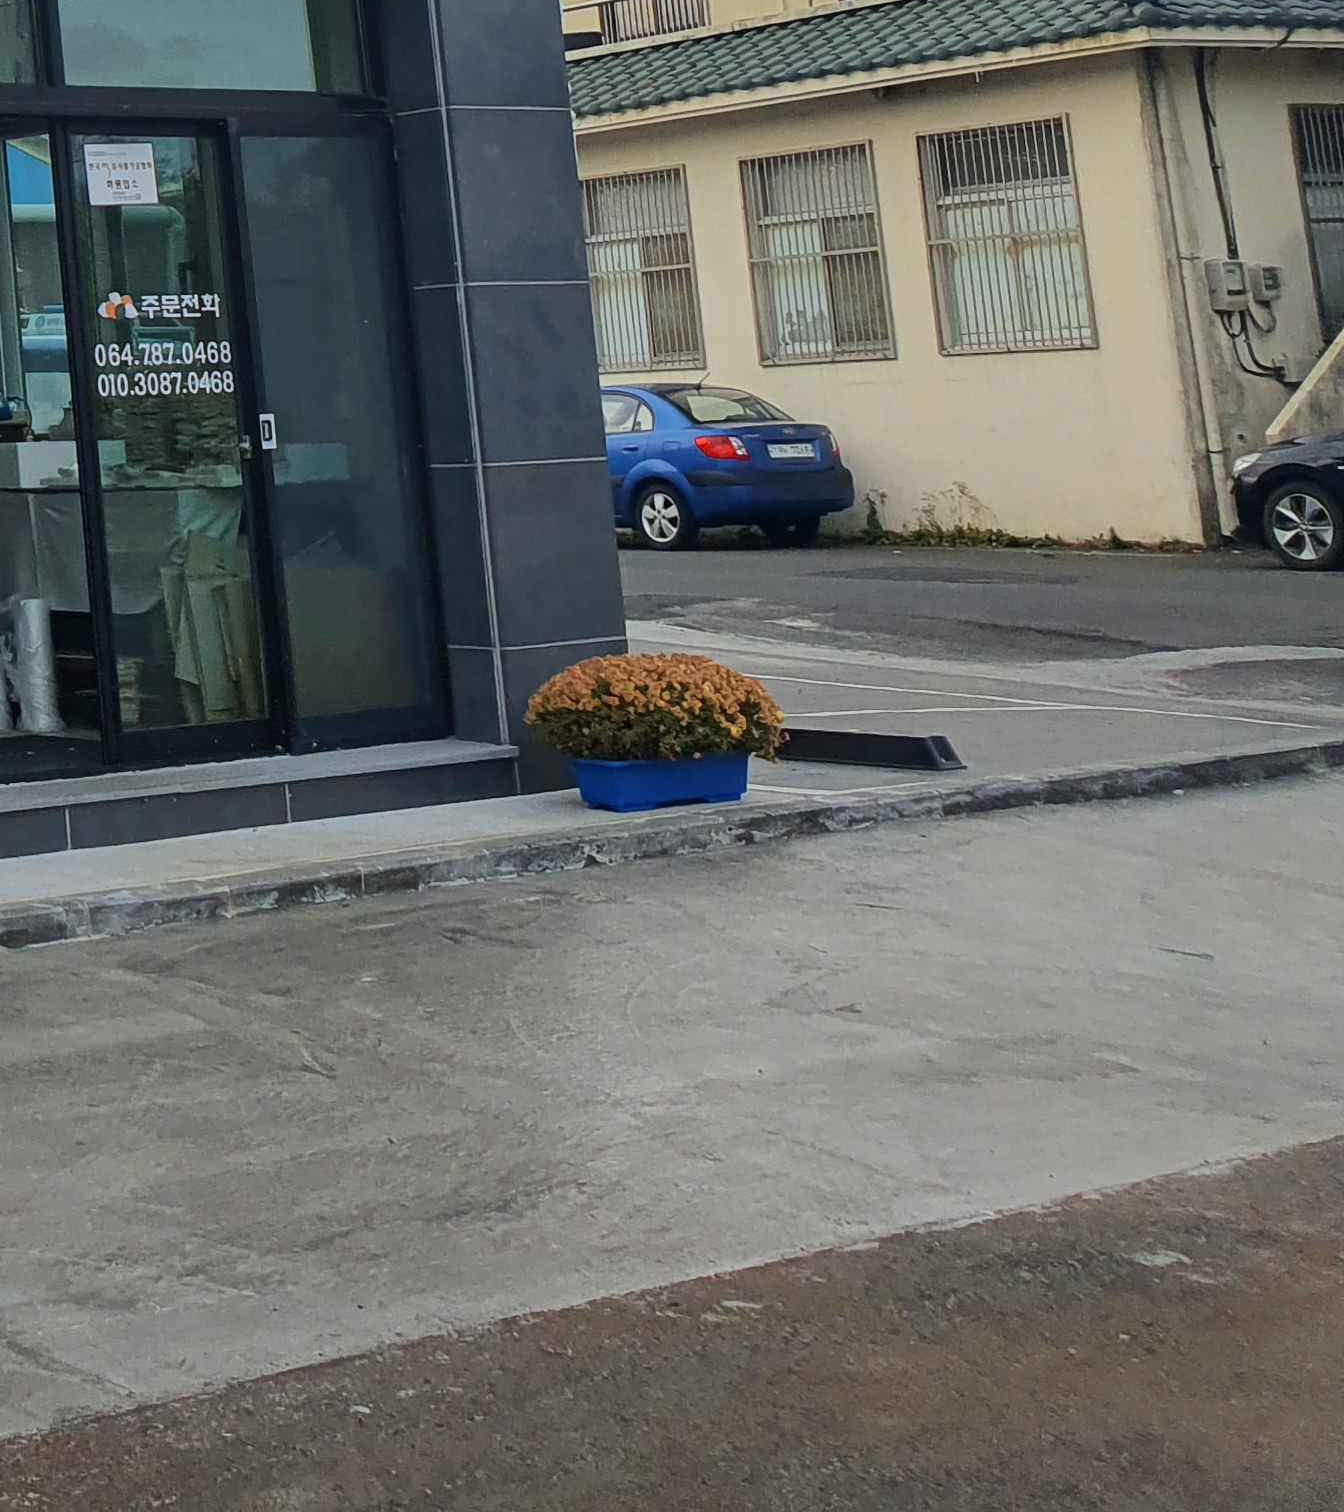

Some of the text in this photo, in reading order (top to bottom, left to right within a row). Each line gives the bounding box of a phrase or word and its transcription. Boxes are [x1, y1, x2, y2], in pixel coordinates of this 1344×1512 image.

[141, 293, 221, 319] 주문전화
[94, 341, 232, 367] 064.787.0468
[97, 370, 234, 397] 010.3087.0468
